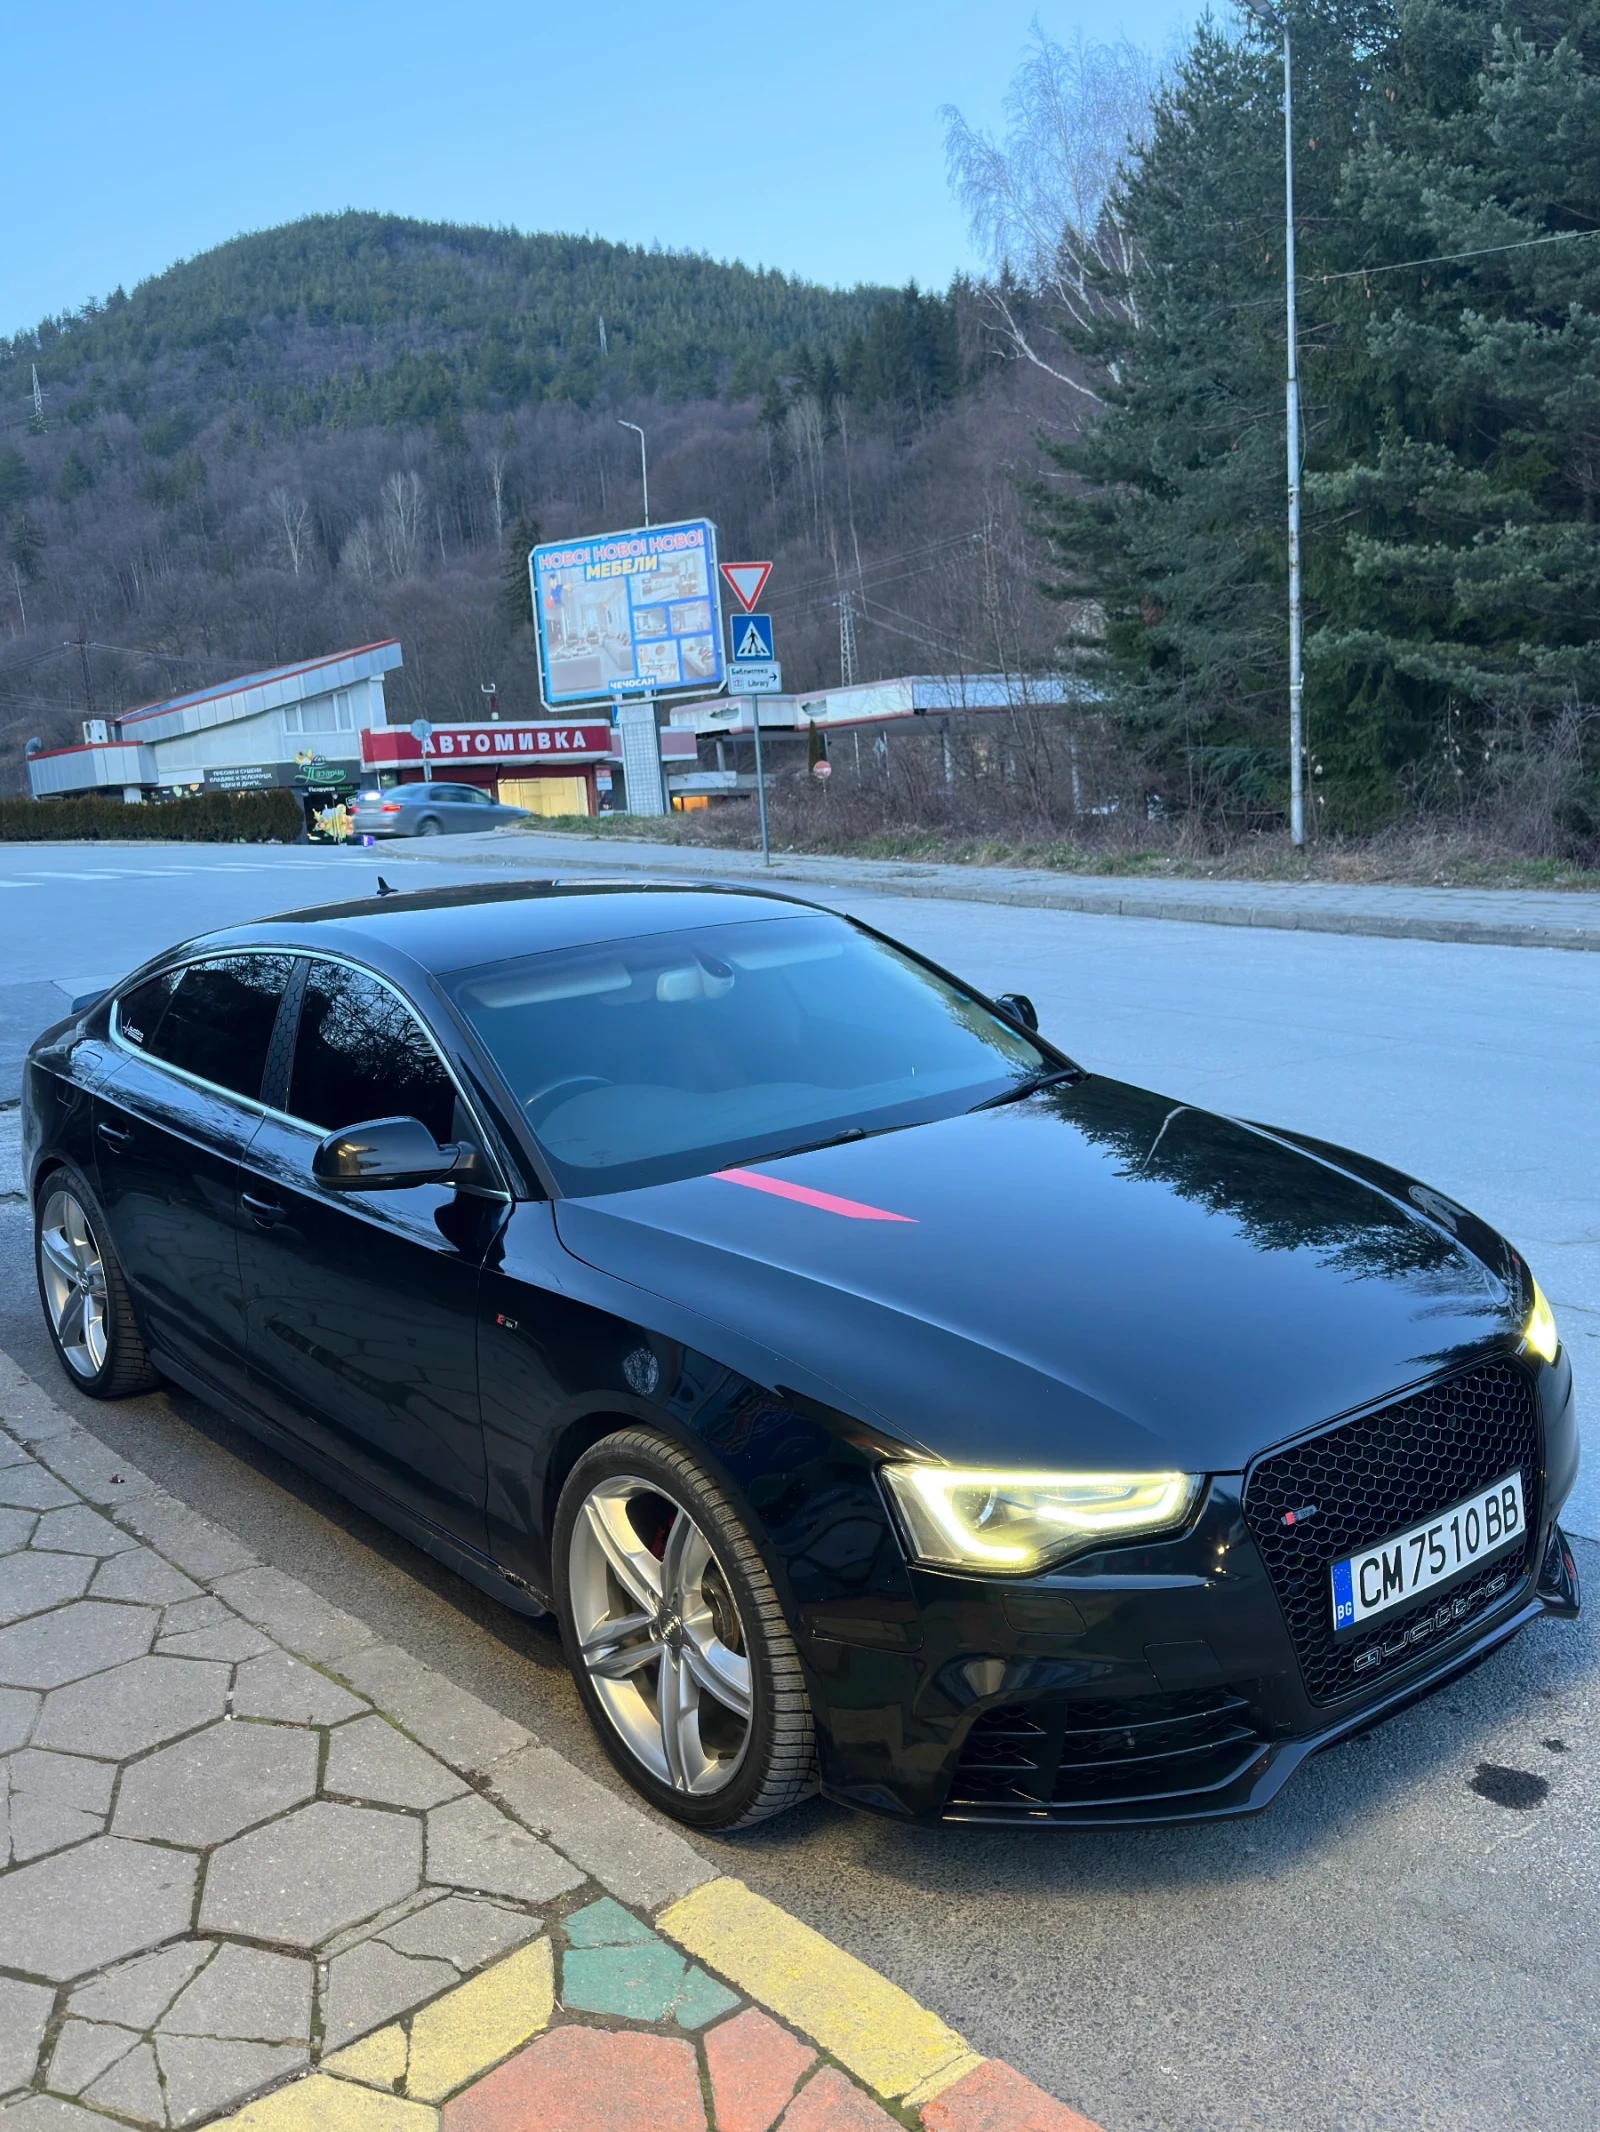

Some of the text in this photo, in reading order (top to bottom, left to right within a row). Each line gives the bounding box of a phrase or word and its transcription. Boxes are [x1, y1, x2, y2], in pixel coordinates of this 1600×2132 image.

[538, 529, 705, 571] НОВО! НОВО! НОВО!
[586, 554, 659, 580] МЕБЕЛИ
[610, 677, 655, 690] ЧЕЧОСАН
[748, 680, 770, 688] Library
[421, 730, 586, 755] АВТОМИВКА
[1337, 1601, 1353, 1620] BG
[1354, 1573, 1507, 1672] quattro
